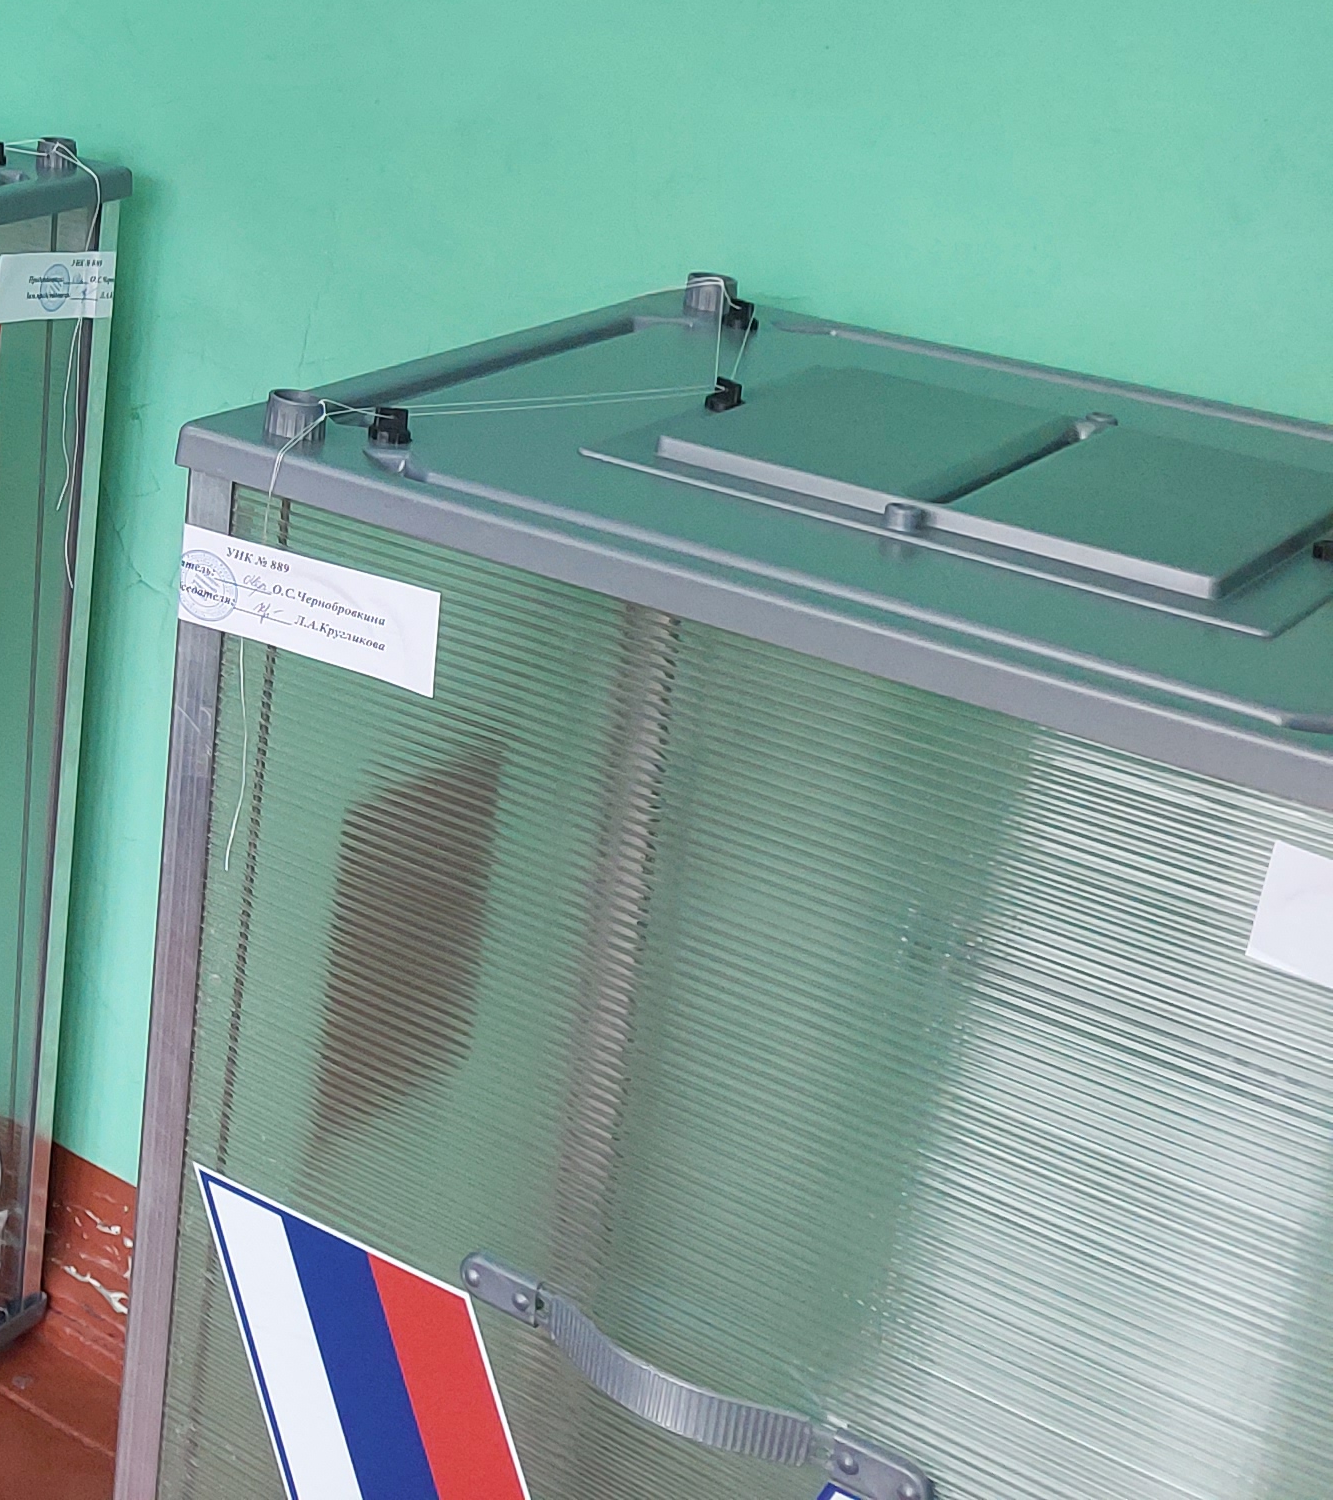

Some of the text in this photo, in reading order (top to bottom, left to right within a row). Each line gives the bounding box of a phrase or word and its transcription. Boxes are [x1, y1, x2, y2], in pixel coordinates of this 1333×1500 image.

[226, 546, 290, 573] УИК № 889
